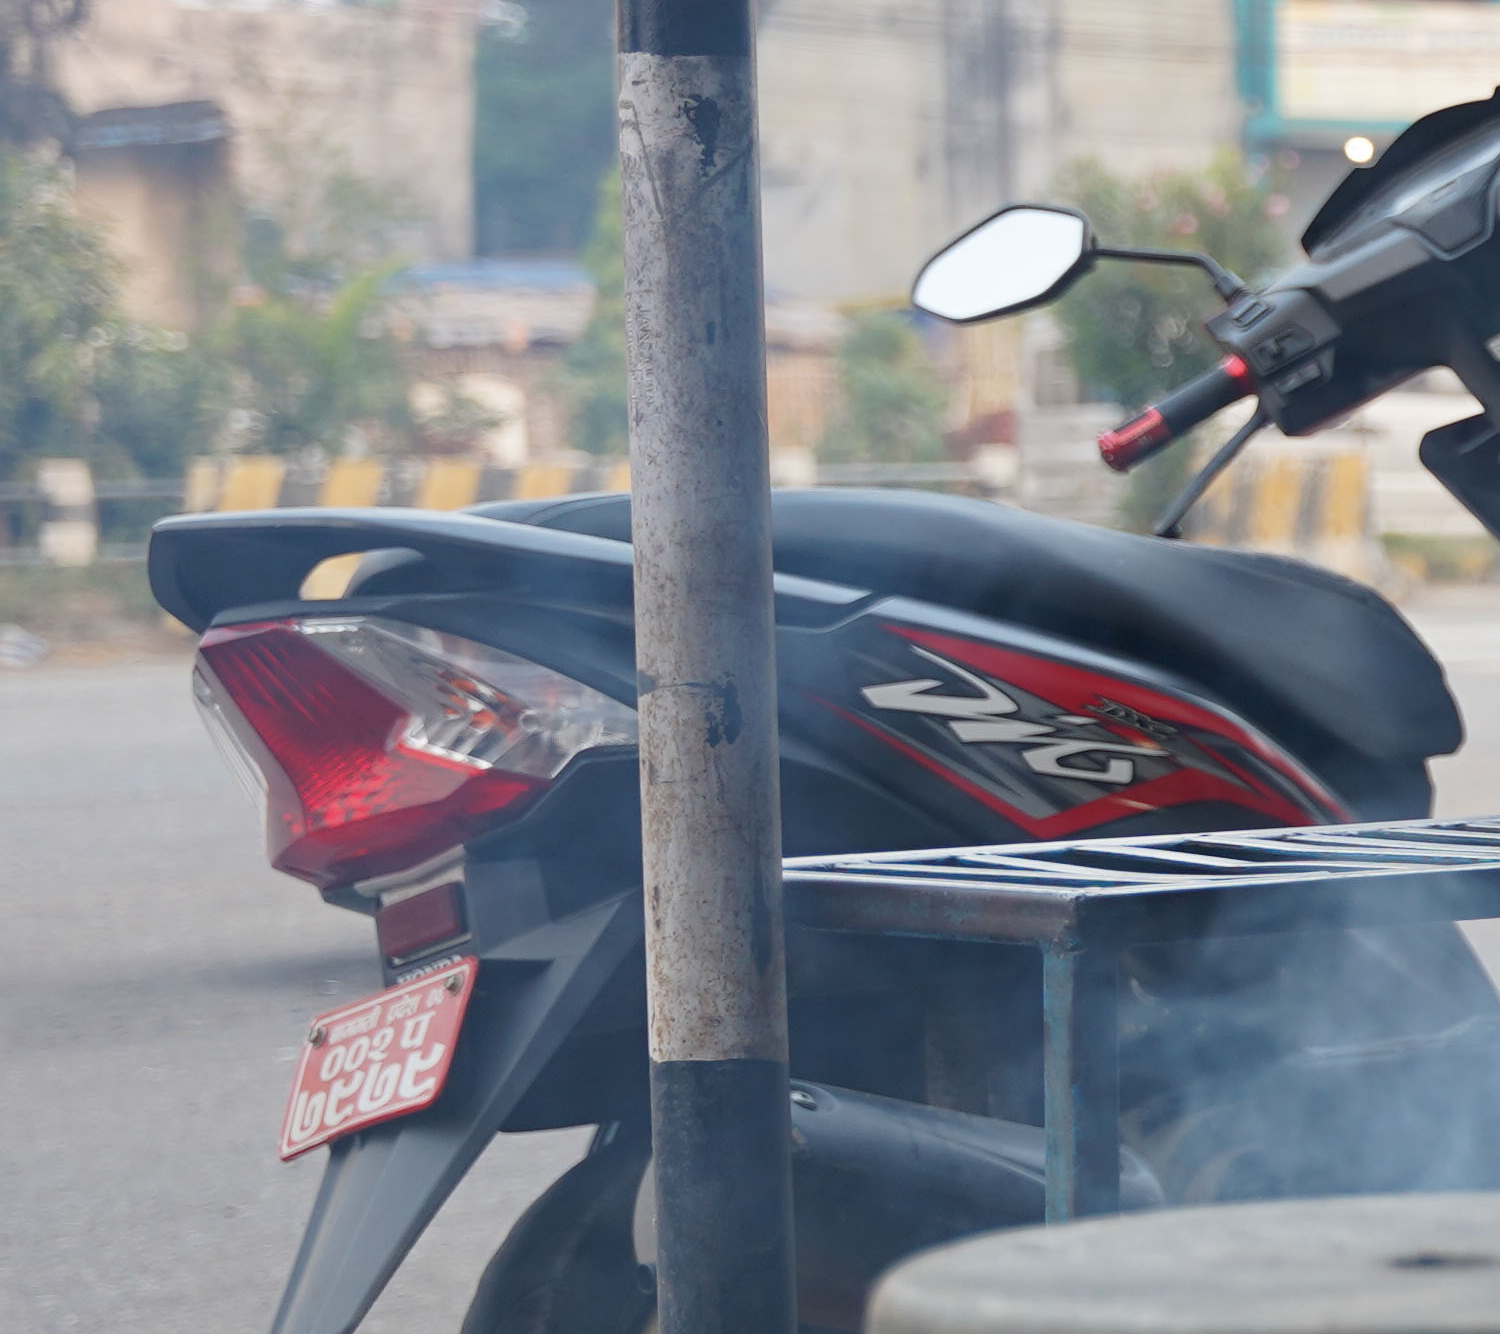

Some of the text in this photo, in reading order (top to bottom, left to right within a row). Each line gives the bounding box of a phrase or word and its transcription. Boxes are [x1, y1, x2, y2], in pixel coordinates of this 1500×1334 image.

[320, 1010, 436, 1082] ००२ प
[289, 1042, 446, 1142] ७९७९
